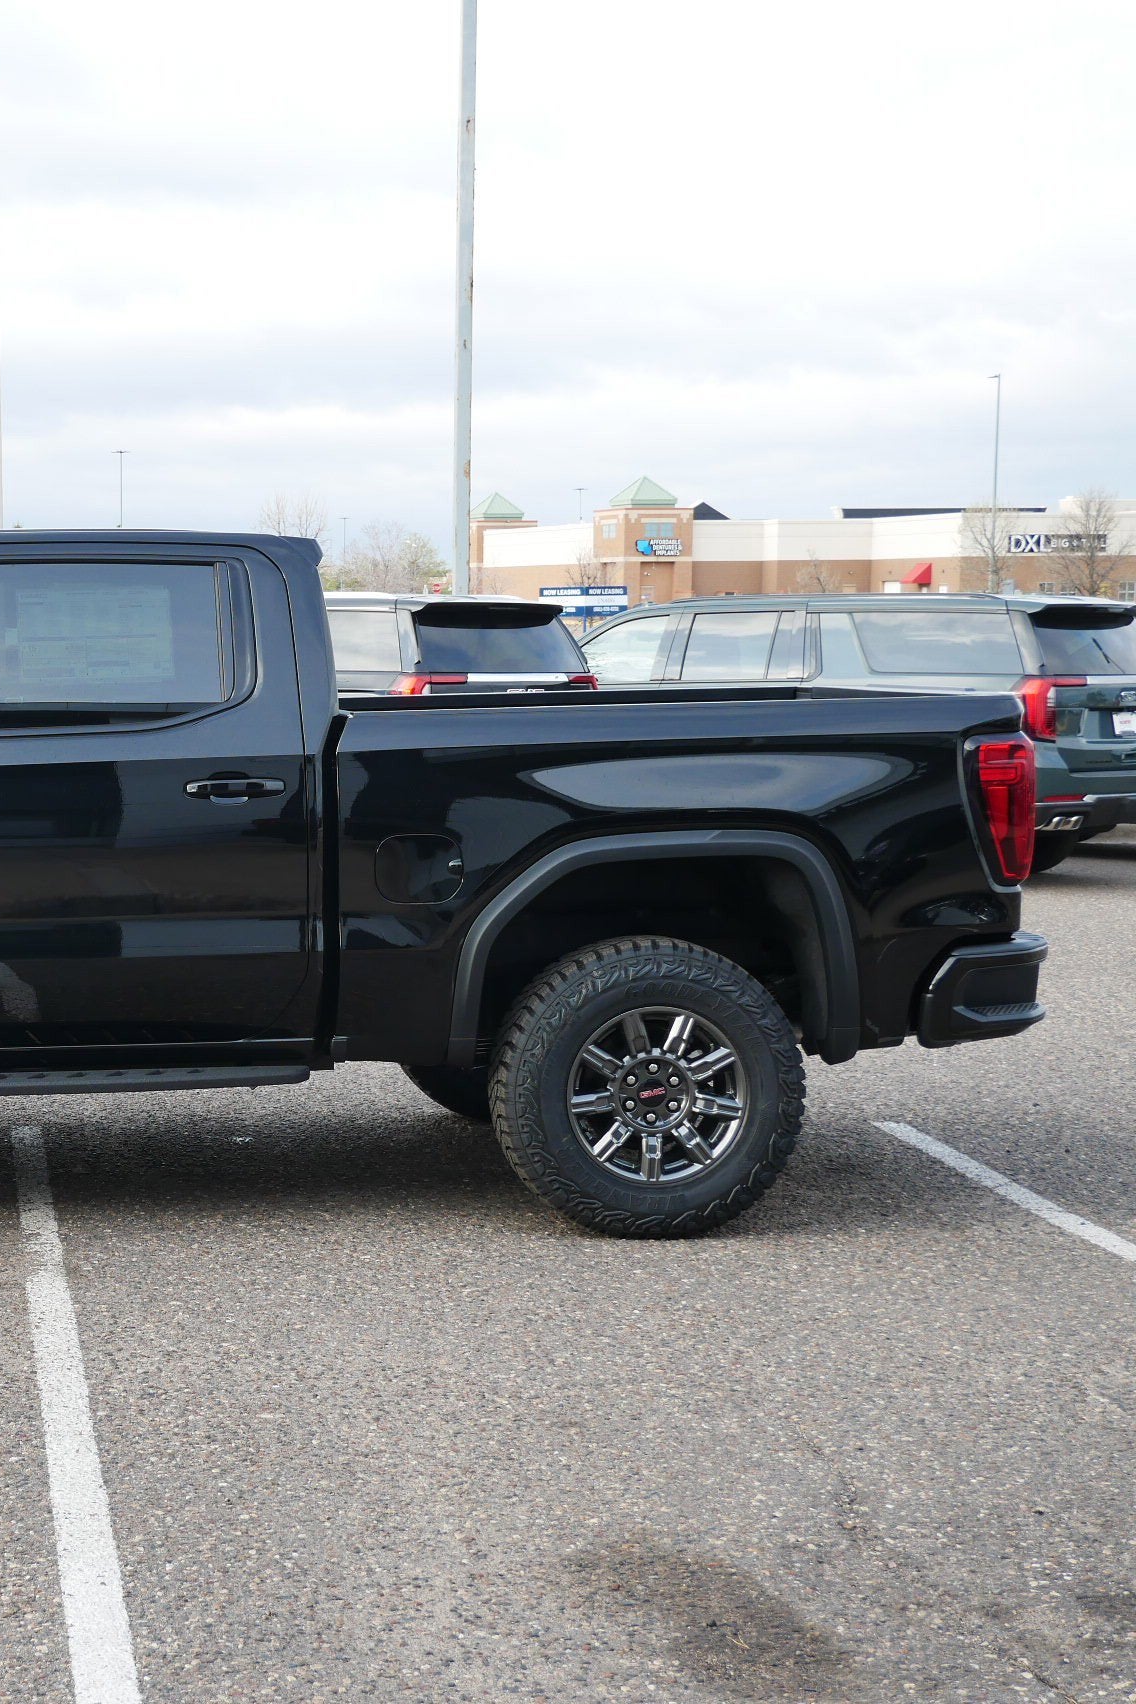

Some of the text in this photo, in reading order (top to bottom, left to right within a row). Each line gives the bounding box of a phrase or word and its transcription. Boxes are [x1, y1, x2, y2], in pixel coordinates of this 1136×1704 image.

[1009, 534, 1052, 553] DXL
[557, 588, 581, 596] LEASING
[640, 1087, 665, 1098] GMC
